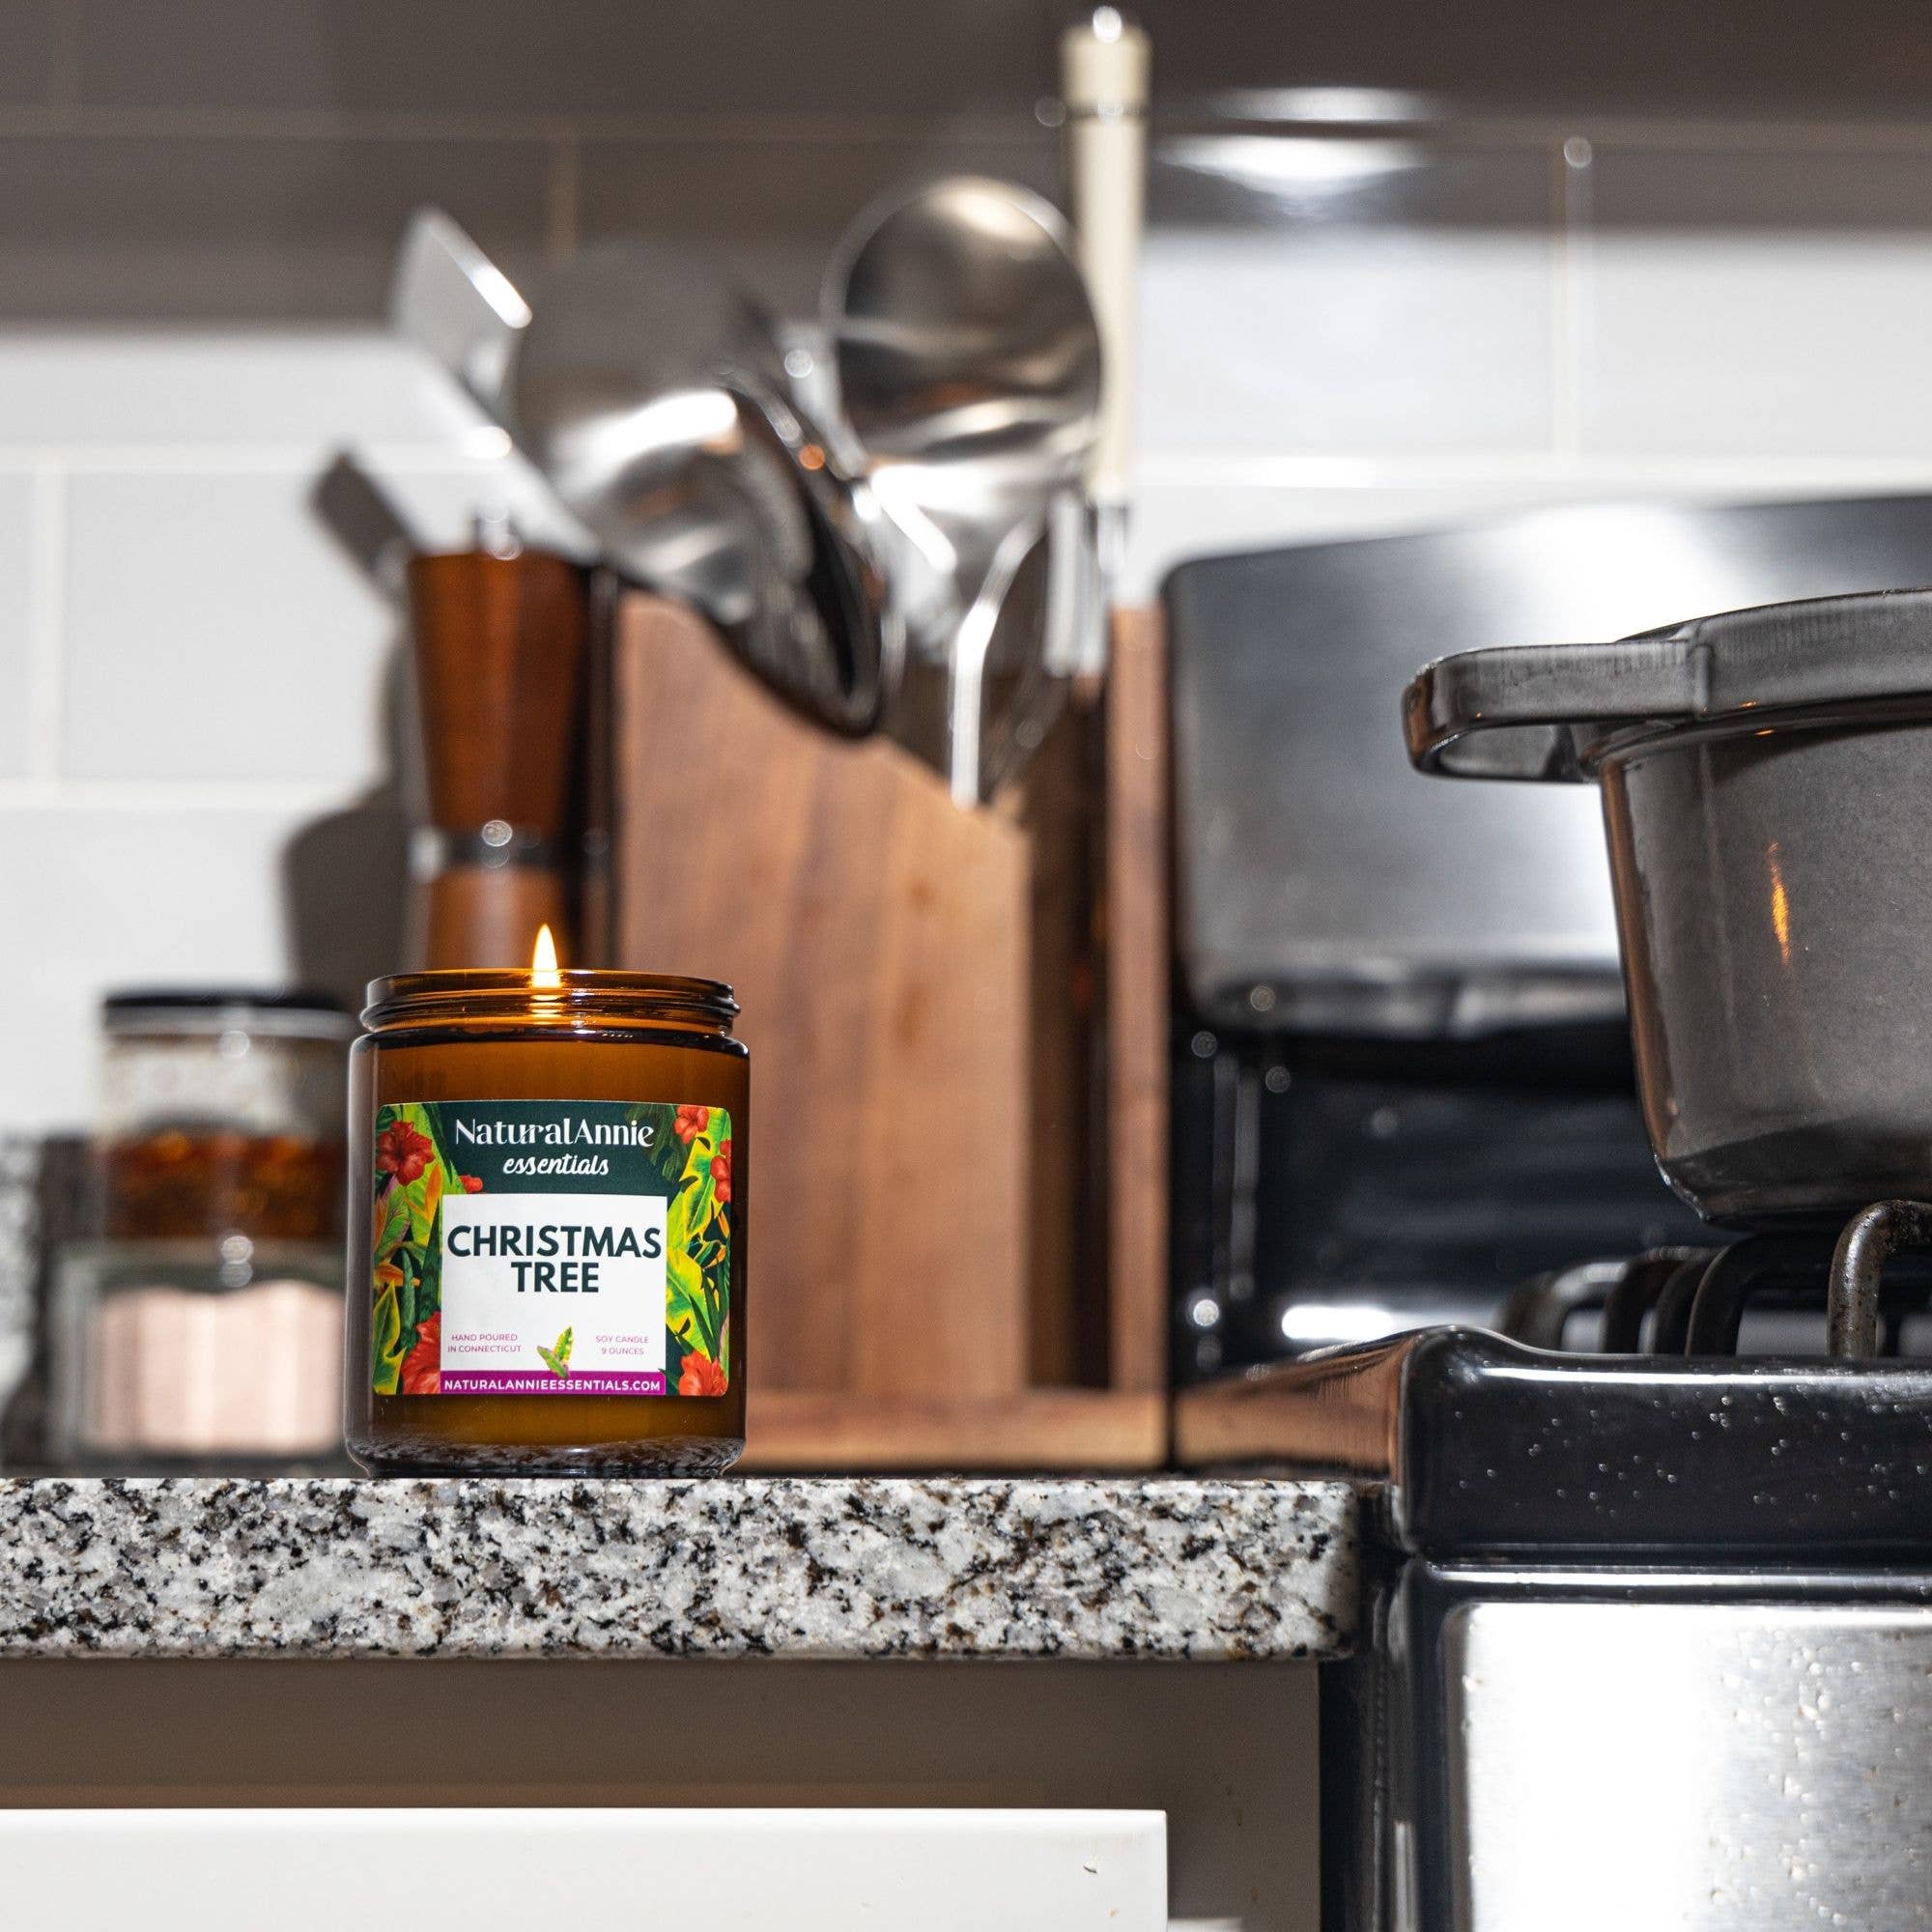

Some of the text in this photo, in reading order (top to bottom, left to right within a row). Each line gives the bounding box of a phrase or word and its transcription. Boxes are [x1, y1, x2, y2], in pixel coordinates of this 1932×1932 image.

[502, 1153, 610, 1175] essentials
[447, 1225, 662, 1259] CHRISTMAS
[511, 1262, 599, 1293] TREE
[479, 1333, 518, 1342] POURED
[595, 1335, 650, 1344] SOY CANDLE
[601, 1347, 644, 1355] 9 OUNCES
[444, 1379, 661, 1391] NATURALANNIEESSENTIALS.COM
